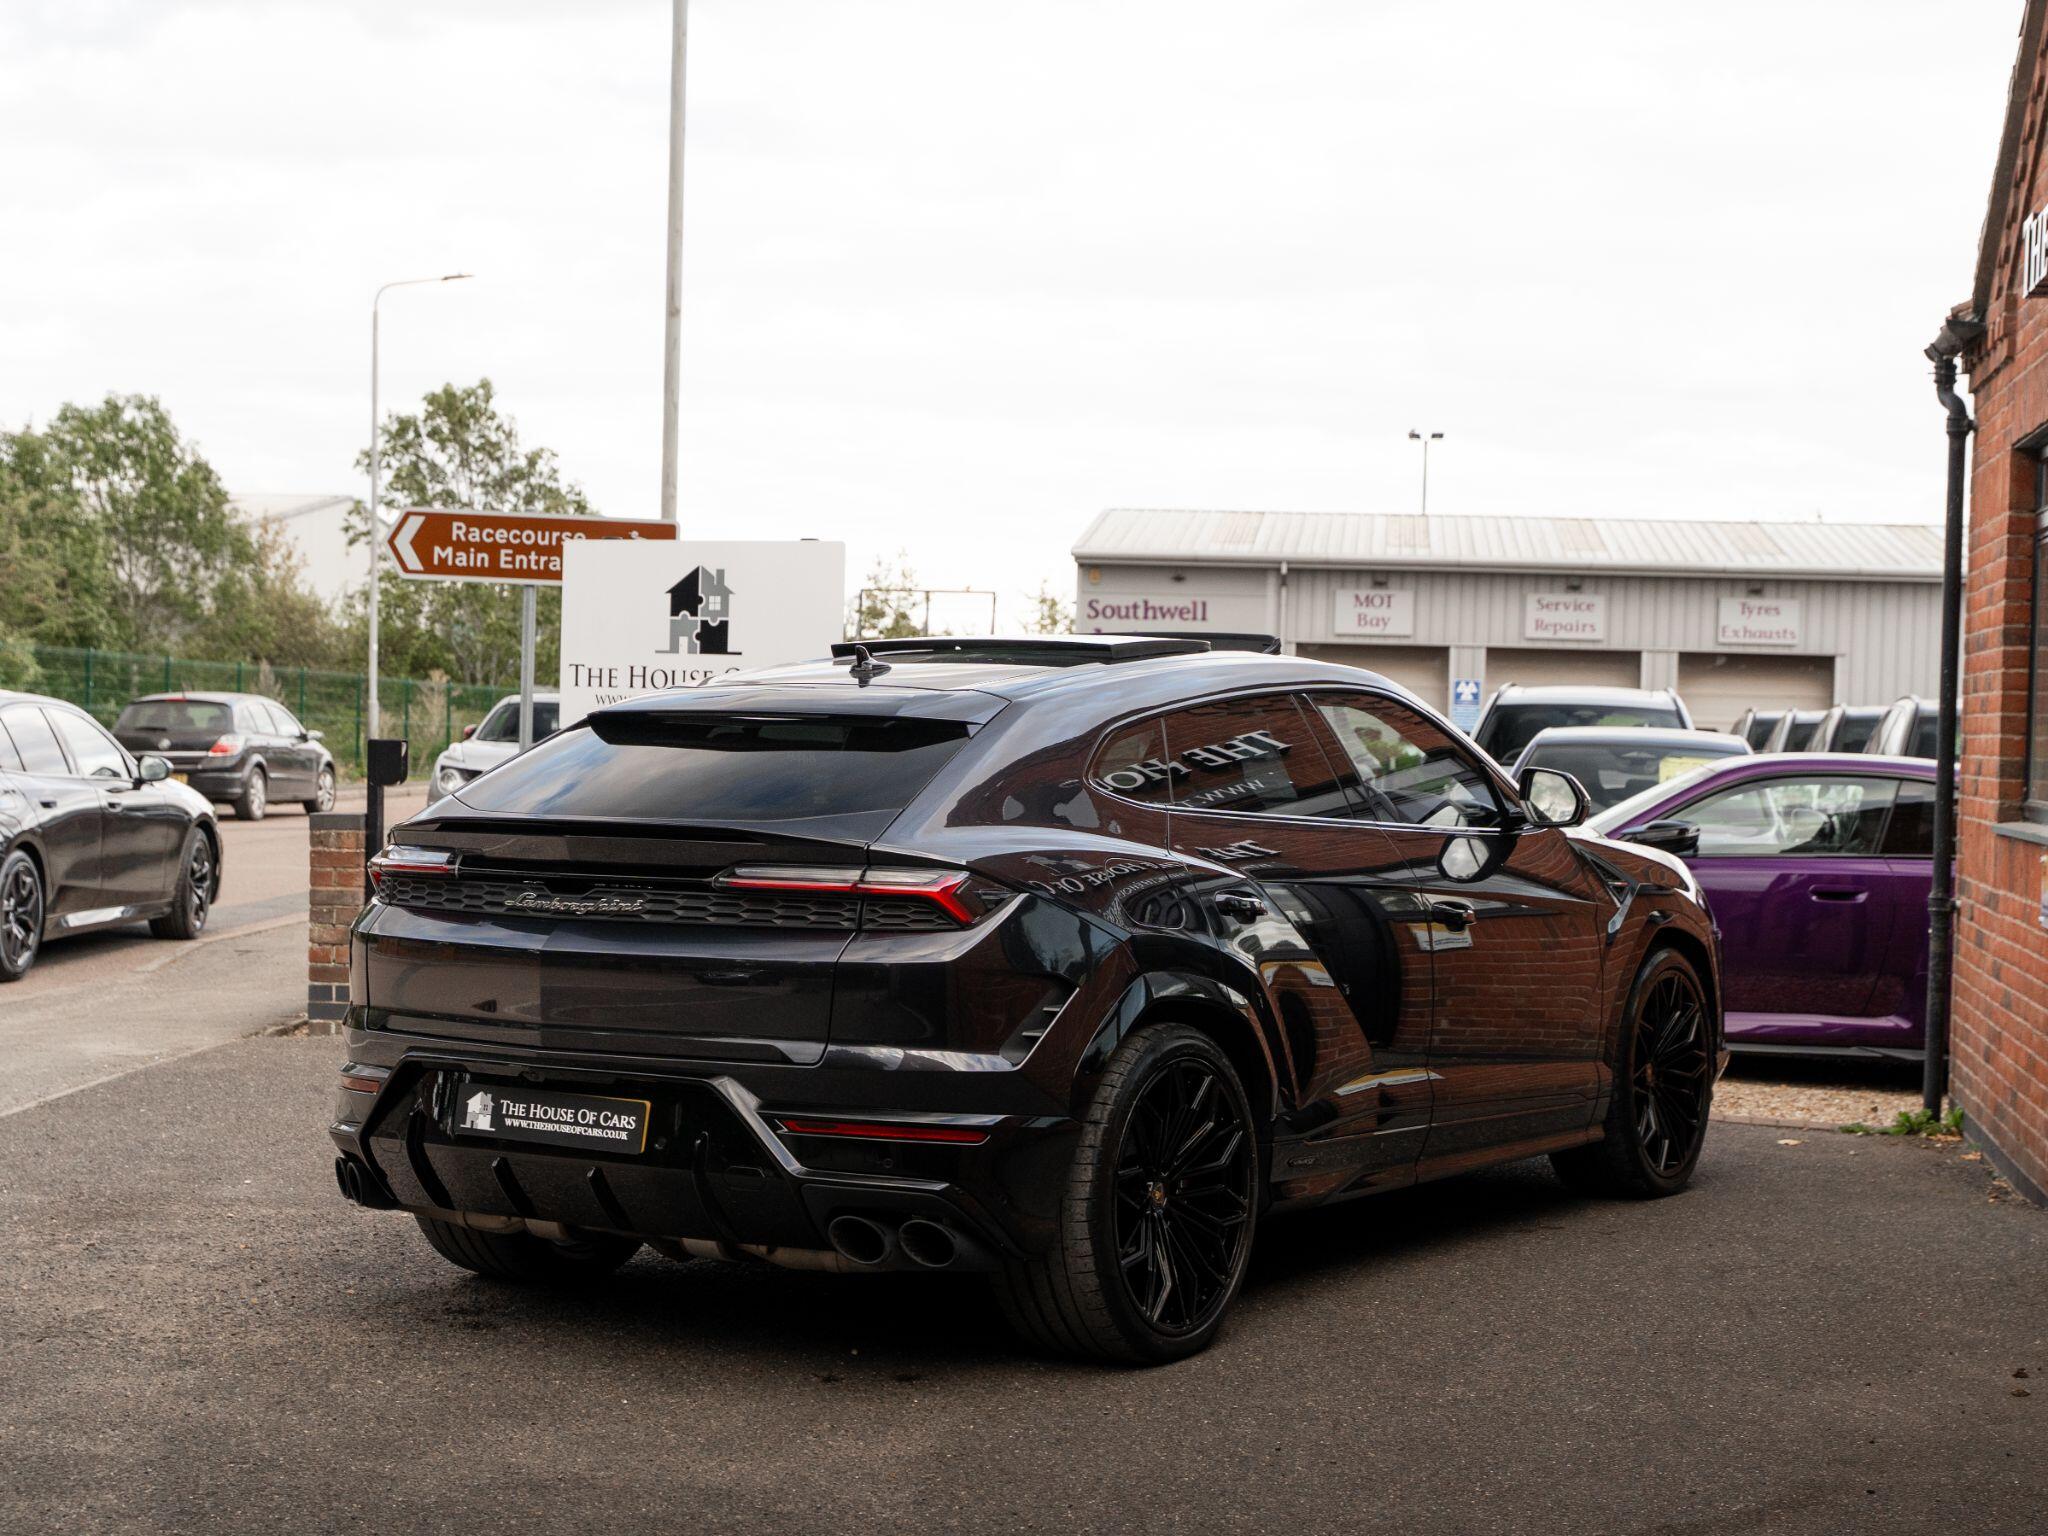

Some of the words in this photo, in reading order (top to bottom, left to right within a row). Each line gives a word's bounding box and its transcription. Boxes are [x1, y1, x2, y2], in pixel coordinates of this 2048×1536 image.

[433, 546, 489, 568] Main
[500, 549, 562, 571] Entra
[1354, 593, 1395, 608] MOT
[1536, 598, 1596, 613] Service
[1086, 599, 1208, 621] Southwell
[1739, 602, 1780, 619] Tyres
[1357, 612, 1391, 630] Bay
[1534, 618, 1596, 634] Repairs
[1721, 625, 1797, 640] Exhausts
[569, 664, 618, 688] THE
[504, 892, 643, 915] Lamborghini
[501, 1100, 526, 1117] THE
[529, 1104, 575, 1123] HOUSE
[577, 1108, 597, 1124] OF
[599, 1111, 636, 1130] CARS
